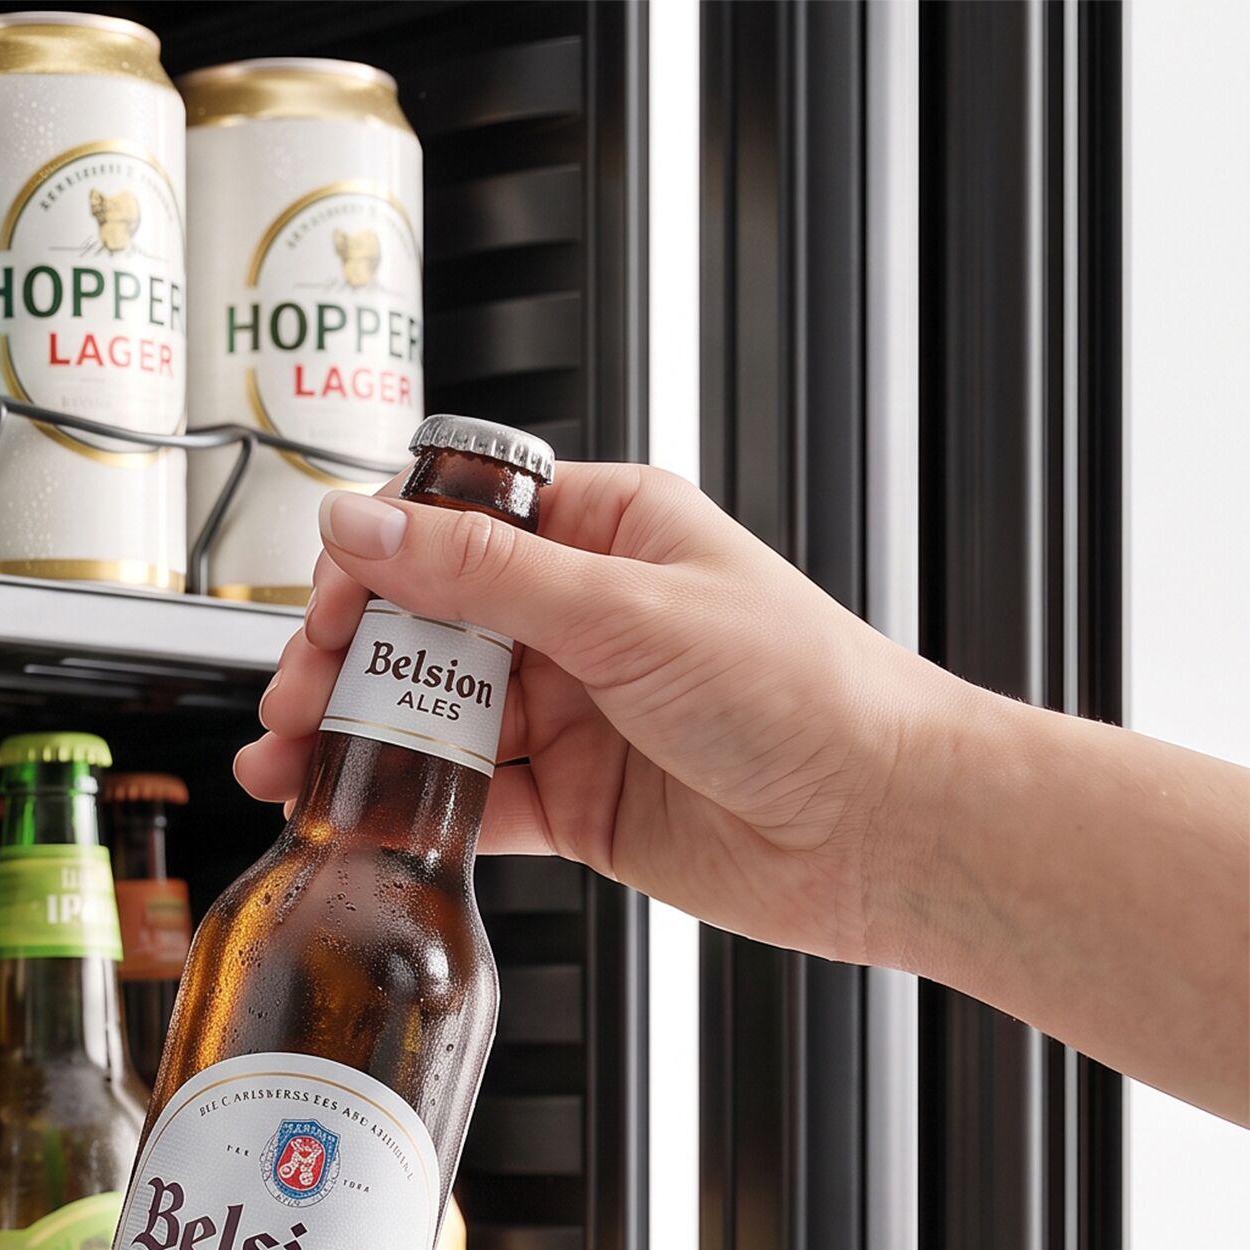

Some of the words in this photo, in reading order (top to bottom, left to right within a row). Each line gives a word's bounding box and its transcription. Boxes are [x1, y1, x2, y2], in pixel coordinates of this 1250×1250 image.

[49, 332, 175, 379] LAGER
[293, 364, 414, 407] LAGER
[364, 640, 493, 709] Belsion
[396, 690, 462, 721] ALES
